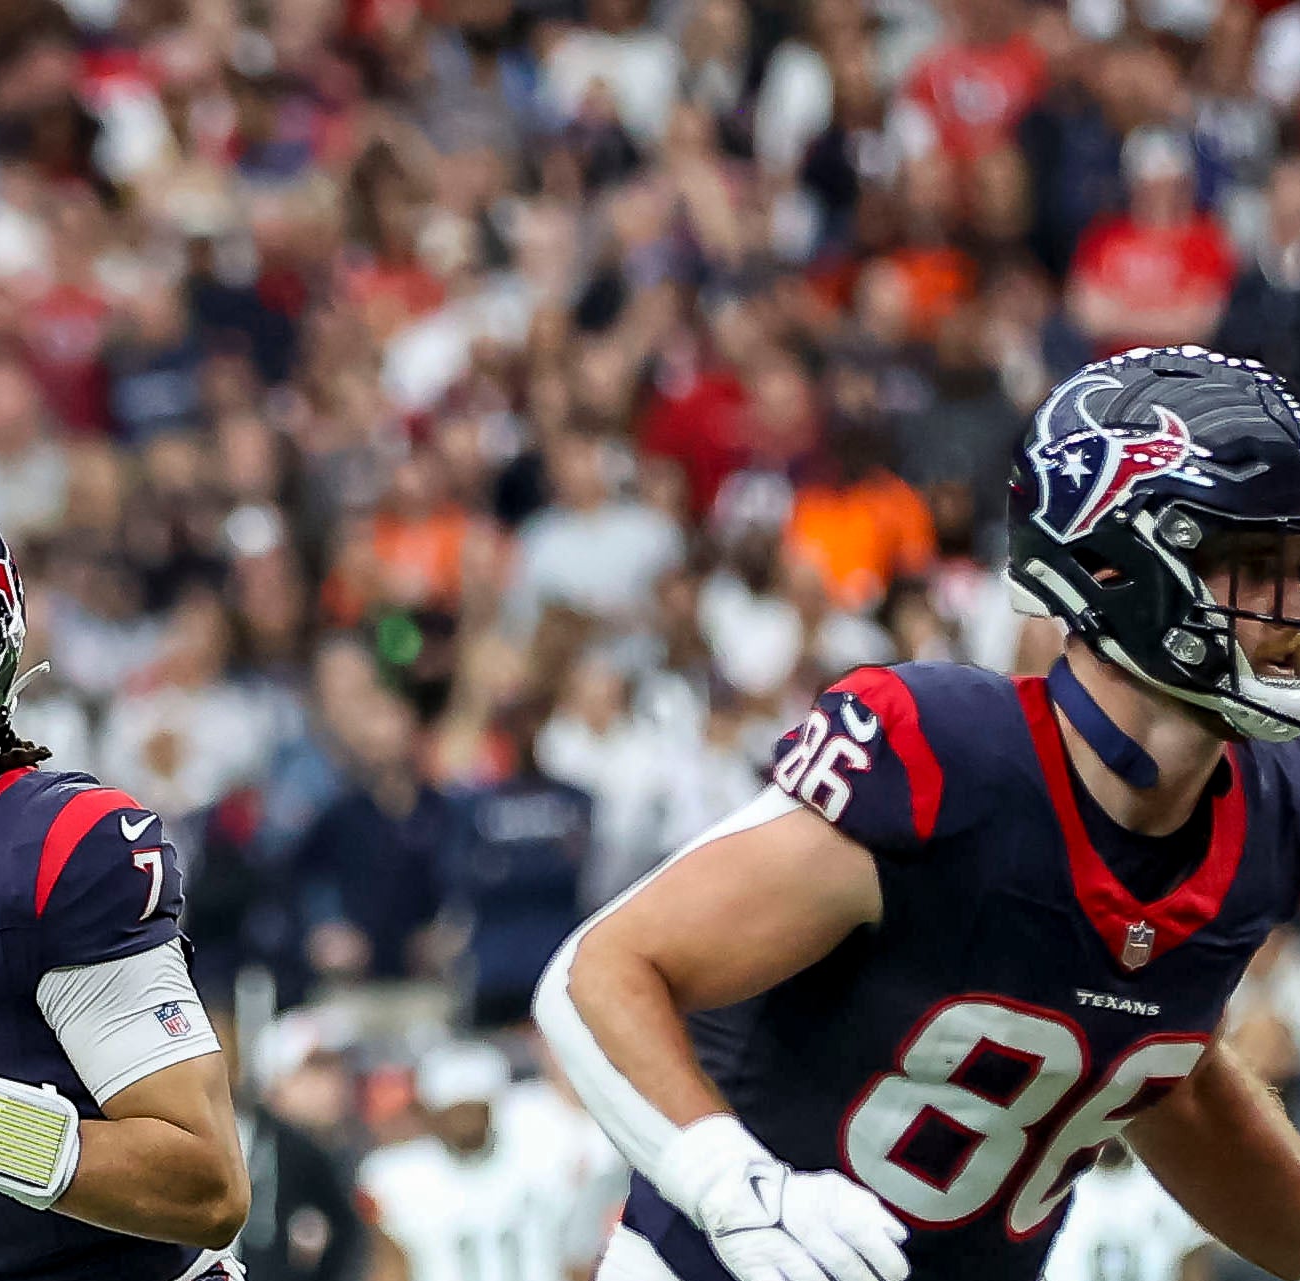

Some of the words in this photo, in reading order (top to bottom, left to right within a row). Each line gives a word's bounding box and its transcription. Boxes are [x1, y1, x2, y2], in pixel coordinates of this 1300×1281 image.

[774, 708, 872, 823] 86
[131, 847, 163, 922] 7
[1076, 991, 1161, 1016] TEXANS
[837, 993, 1213, 1243] 86
